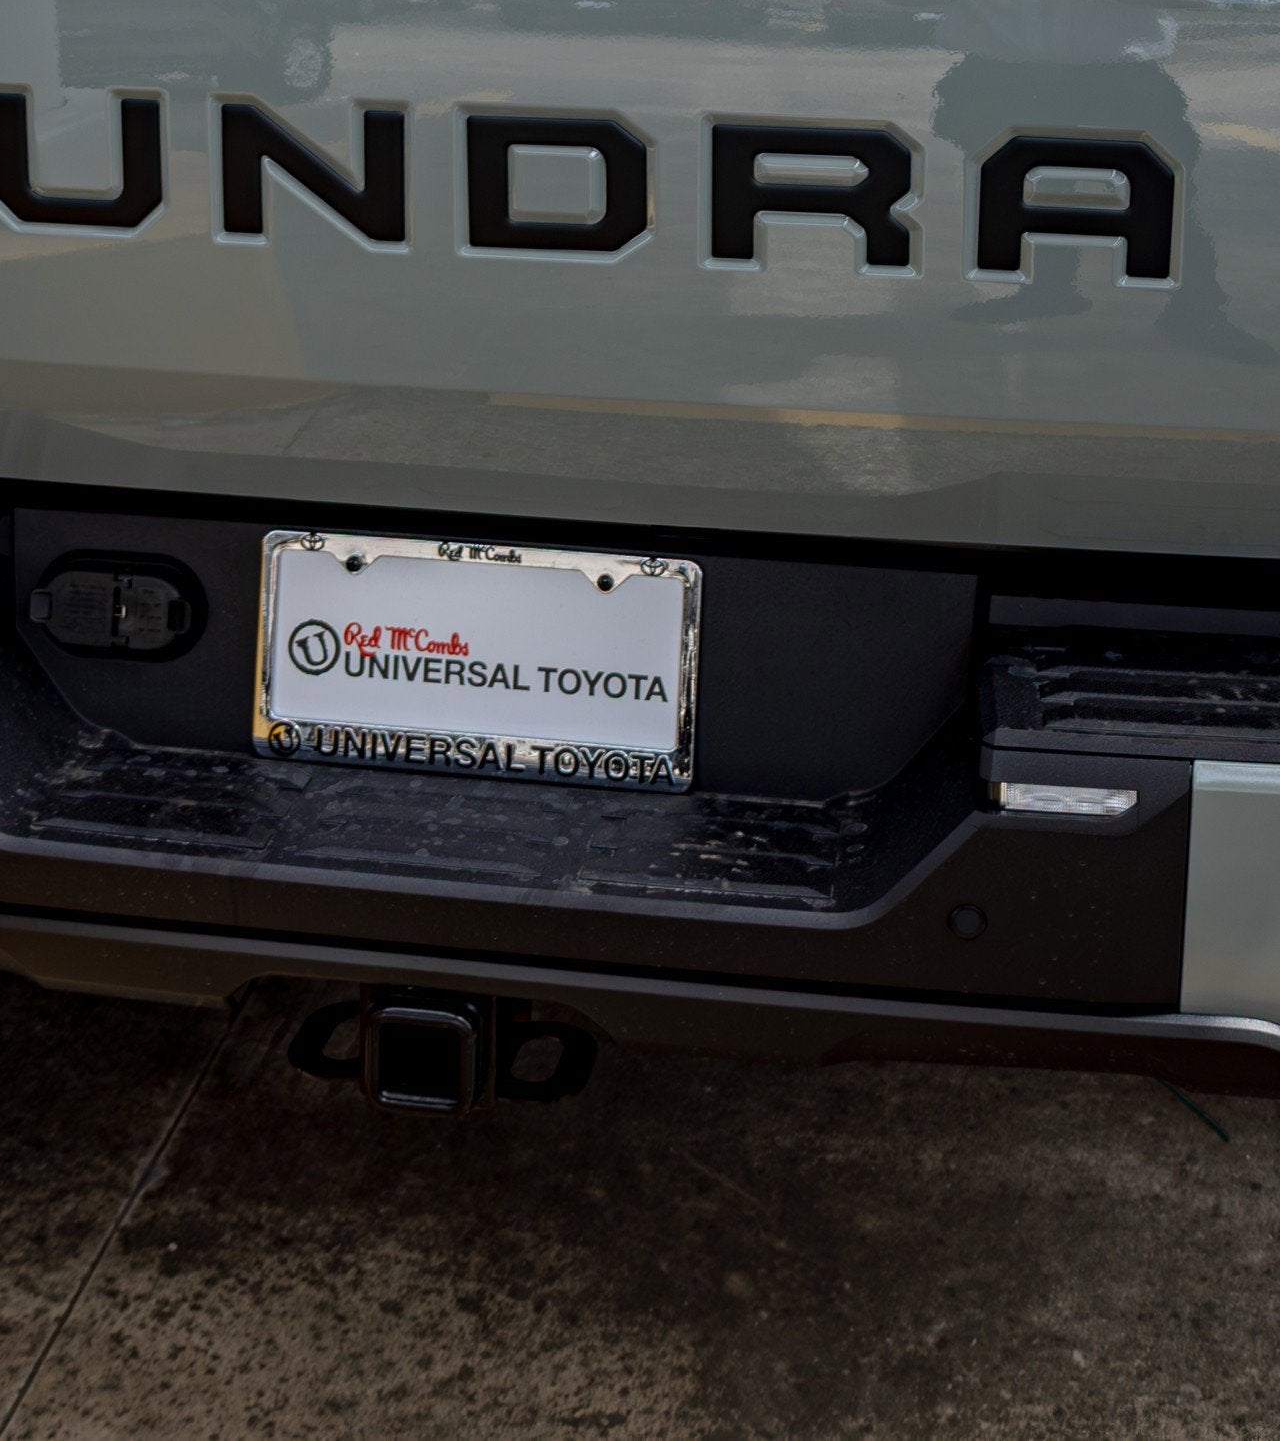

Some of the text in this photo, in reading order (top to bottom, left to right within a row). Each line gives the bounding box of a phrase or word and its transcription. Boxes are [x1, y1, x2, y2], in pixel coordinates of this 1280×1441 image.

[438, 541, 463, 561] Red
[343, 622, 469, 657] Red McCombs
[344, 650, 668, 702] UNIVERSAL TOYOTA
[315, 724, 526, 772] UNIVERSAL
[531, 744, 676, 785] TOYOTA
